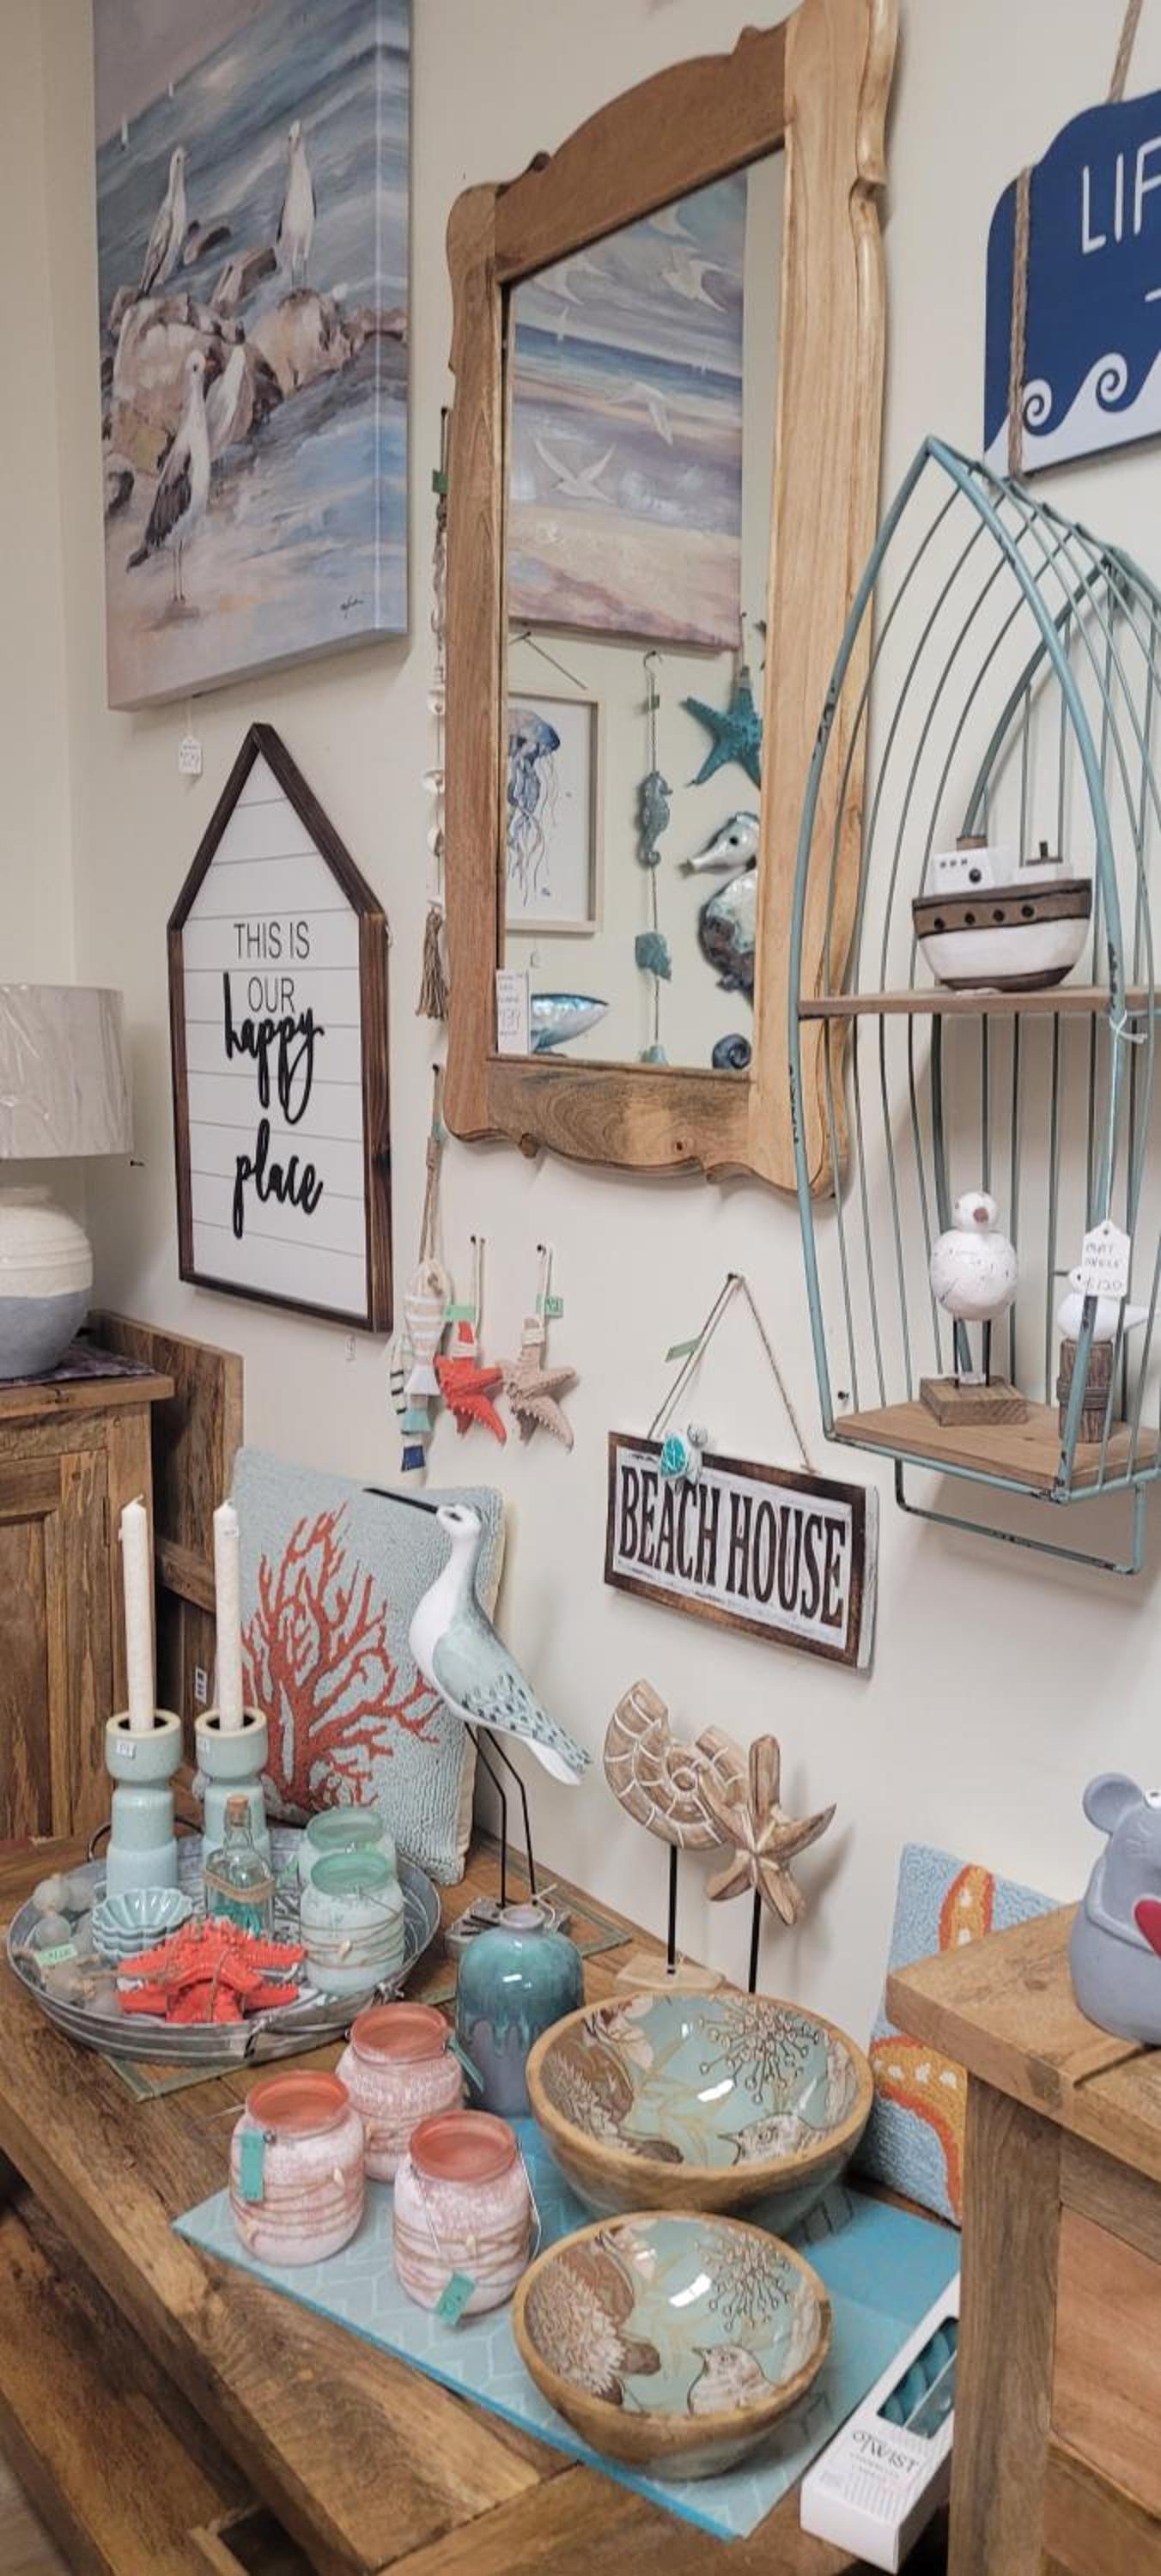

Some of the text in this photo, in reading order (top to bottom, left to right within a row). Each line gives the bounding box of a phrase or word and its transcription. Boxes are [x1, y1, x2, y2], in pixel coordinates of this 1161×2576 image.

[234, 920, 310, 960] THIS IS
[247, 976, 295, 1014] OUR
[223, 971, 325, 1125] happy
[233, 1118, 324, 1239] place
[618, 1465, 846, 1628] BEACH HOUSE
